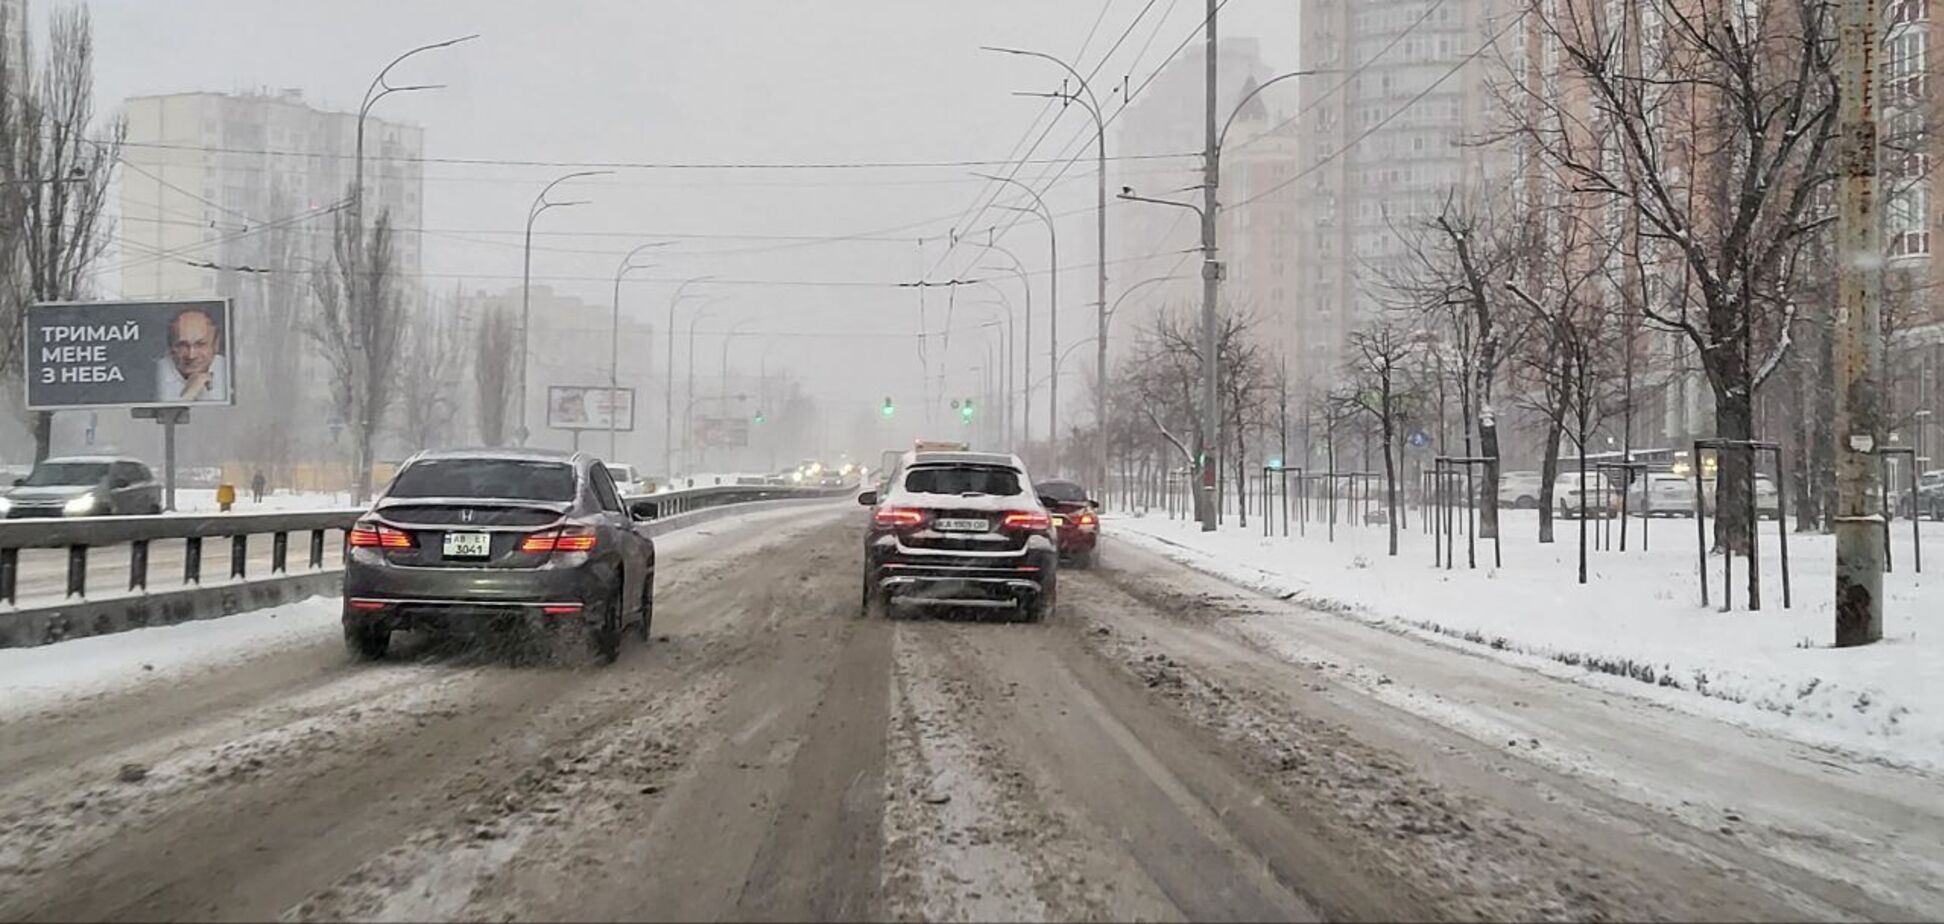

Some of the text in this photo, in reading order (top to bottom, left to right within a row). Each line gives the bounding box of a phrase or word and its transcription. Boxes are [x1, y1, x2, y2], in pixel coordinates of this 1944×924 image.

[41, 320, 139, 341] ТРИМАЙ
[42, 346, 107, 362] МЕНЕ
[61, 366, 124, 382] НЕБА
[455, 544, 483, 554] 3041
